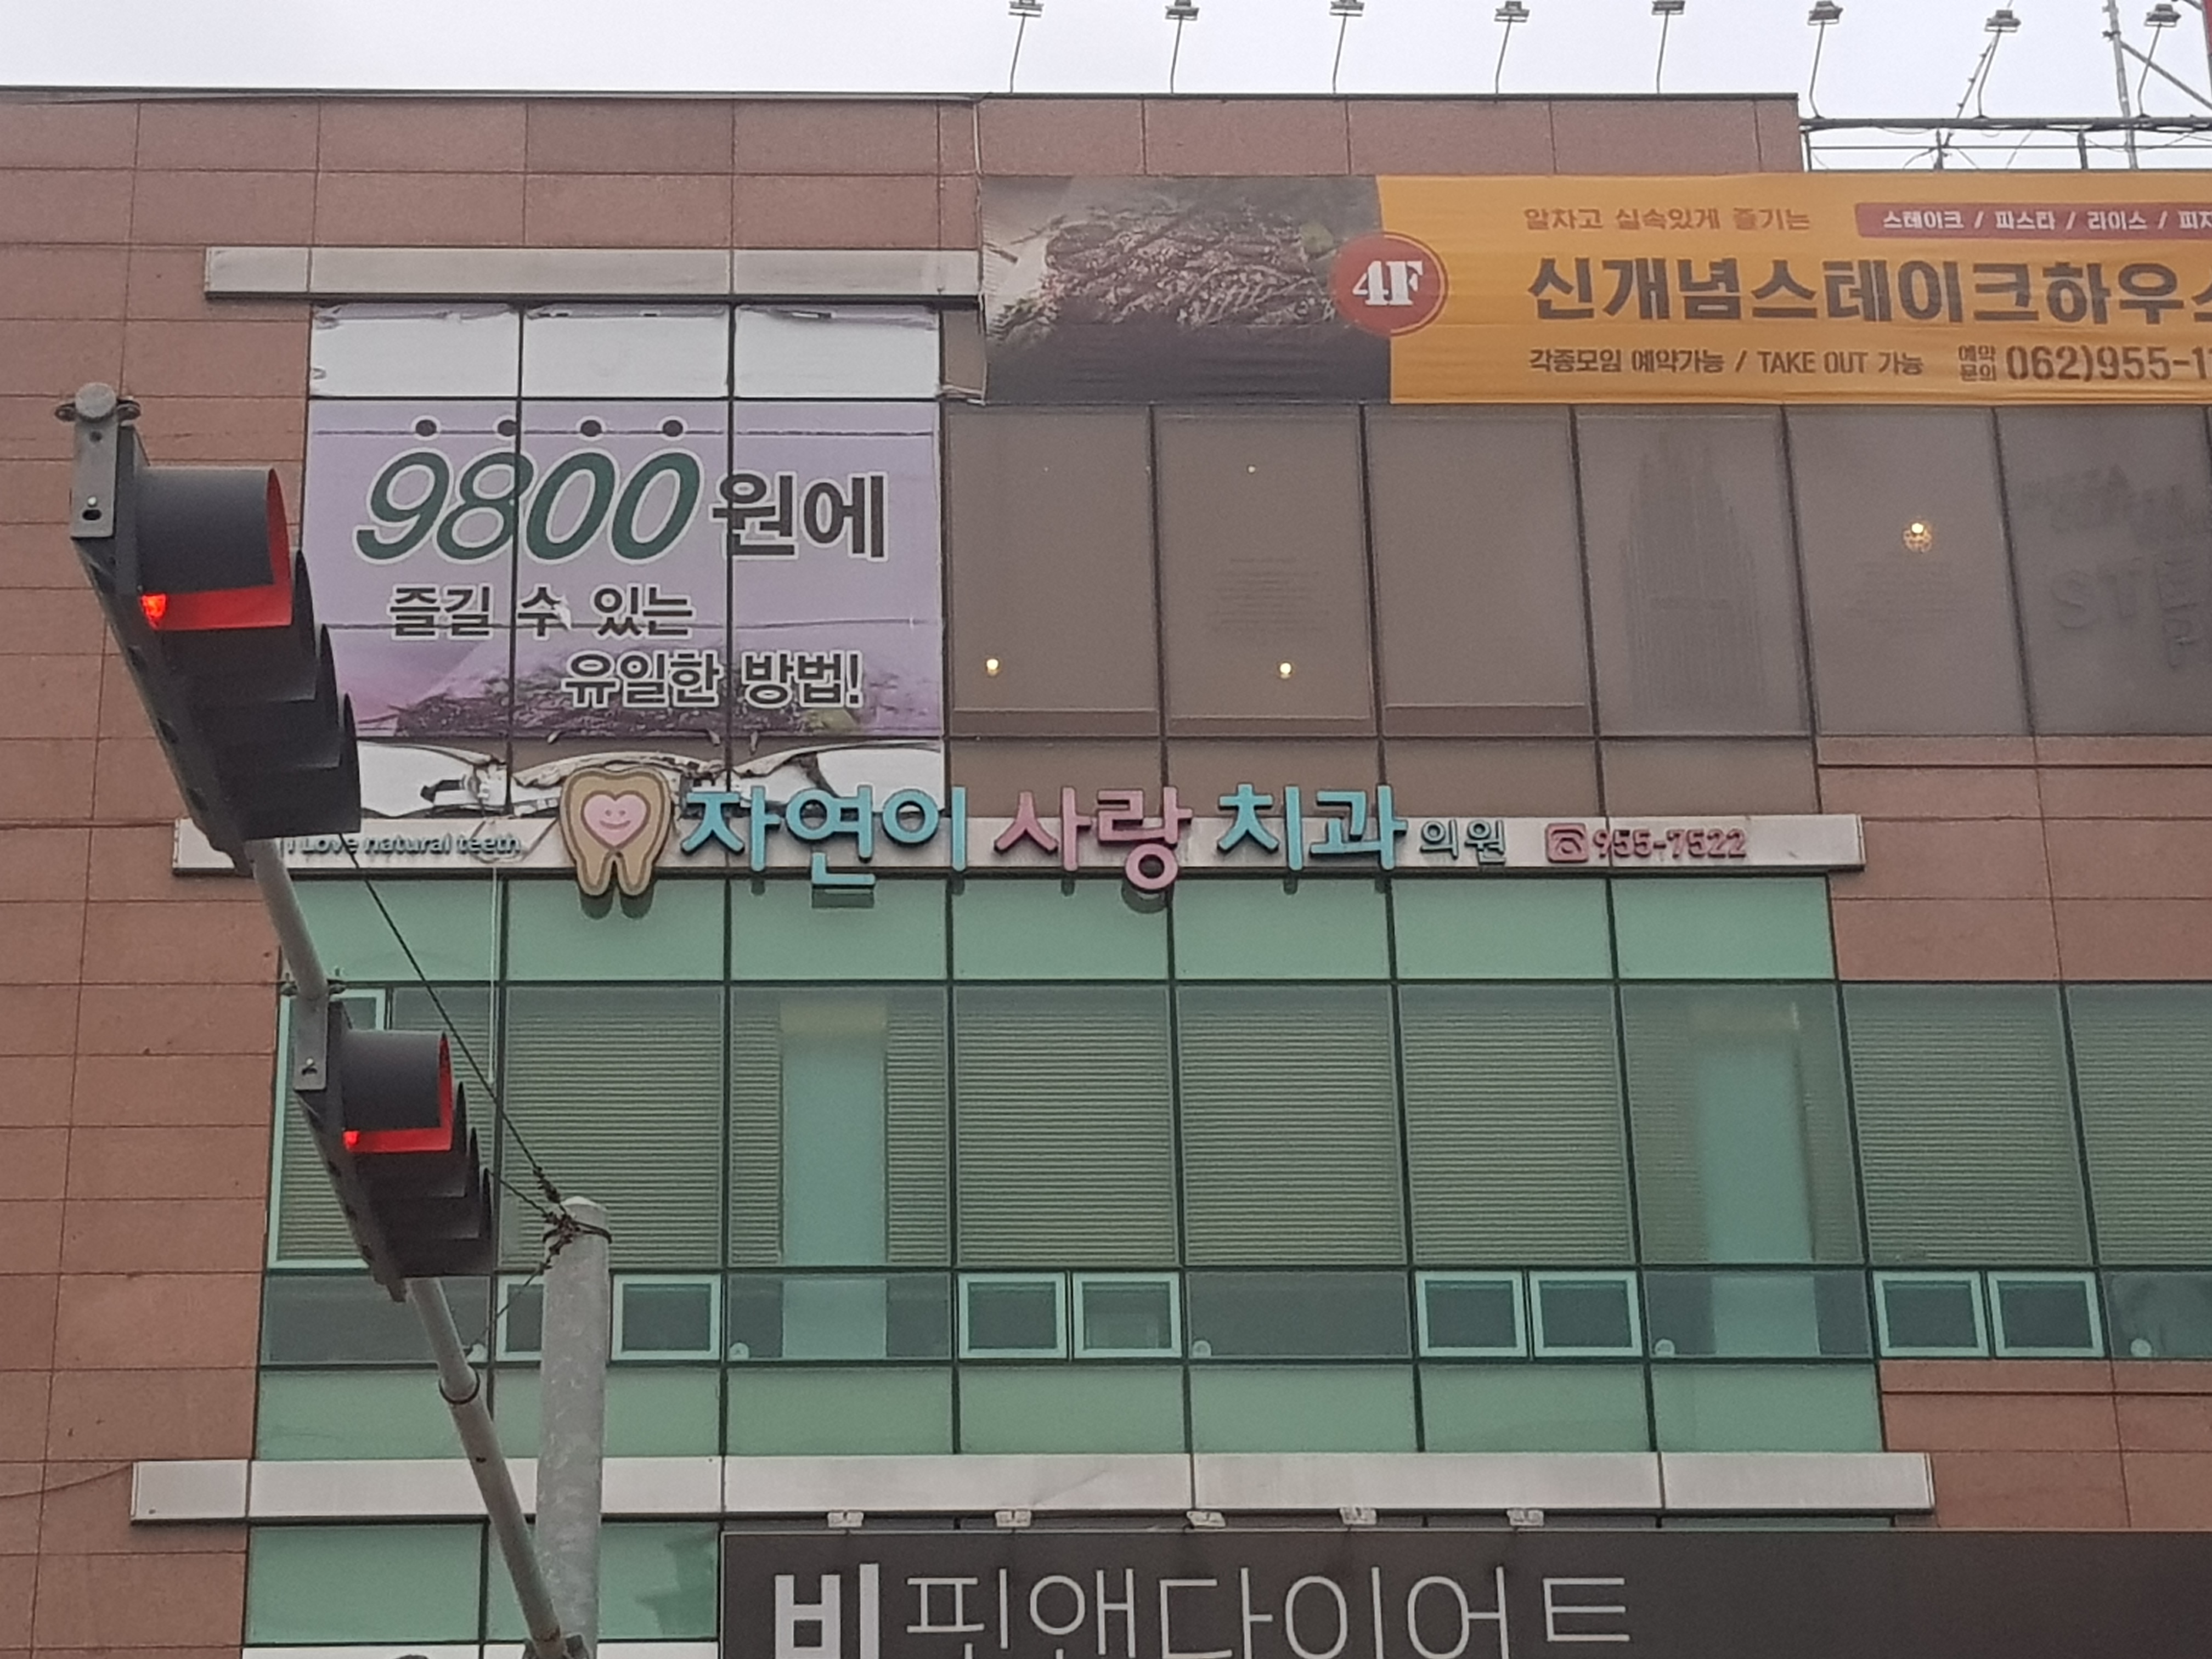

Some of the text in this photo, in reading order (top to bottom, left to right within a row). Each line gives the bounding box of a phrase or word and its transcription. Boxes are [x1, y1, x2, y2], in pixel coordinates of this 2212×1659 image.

[1524, 207, 1810, 230] 알차고 실속있게 즐기는
[1883, 210, 1964, 230] 스테이크
[2087, 210, 2147, 230] 라이스
[1353, 261, 1423, 306] 4F
[1530, 349, 1622, 374] 각종모임
[1632, 349, 1724, 374] 예약가능
[1757, 351, 1816, 374] TAKE
[1823, 351, 1868, 374] OUT
[1877, 351, 1924, 375] 가능
[1959, 345, 1996, 362] 예약
[2006, 345, 2212, 382] 062)955-1
[1960, 364, 1997, 381] 문의
[356, 452, 885, 561] 9800 원에
[390, 586, 693, 637] 즐길 수 있는
[565, 653, 862, 706] 유일한 방법!
[364, 832, 452, 855] natural
[457, 832, 521, 855] teeth
[681, 783, 1506, 892] 자연이 사랑 치과 의원
[1593, 828, 1747, 858] 955-7522
